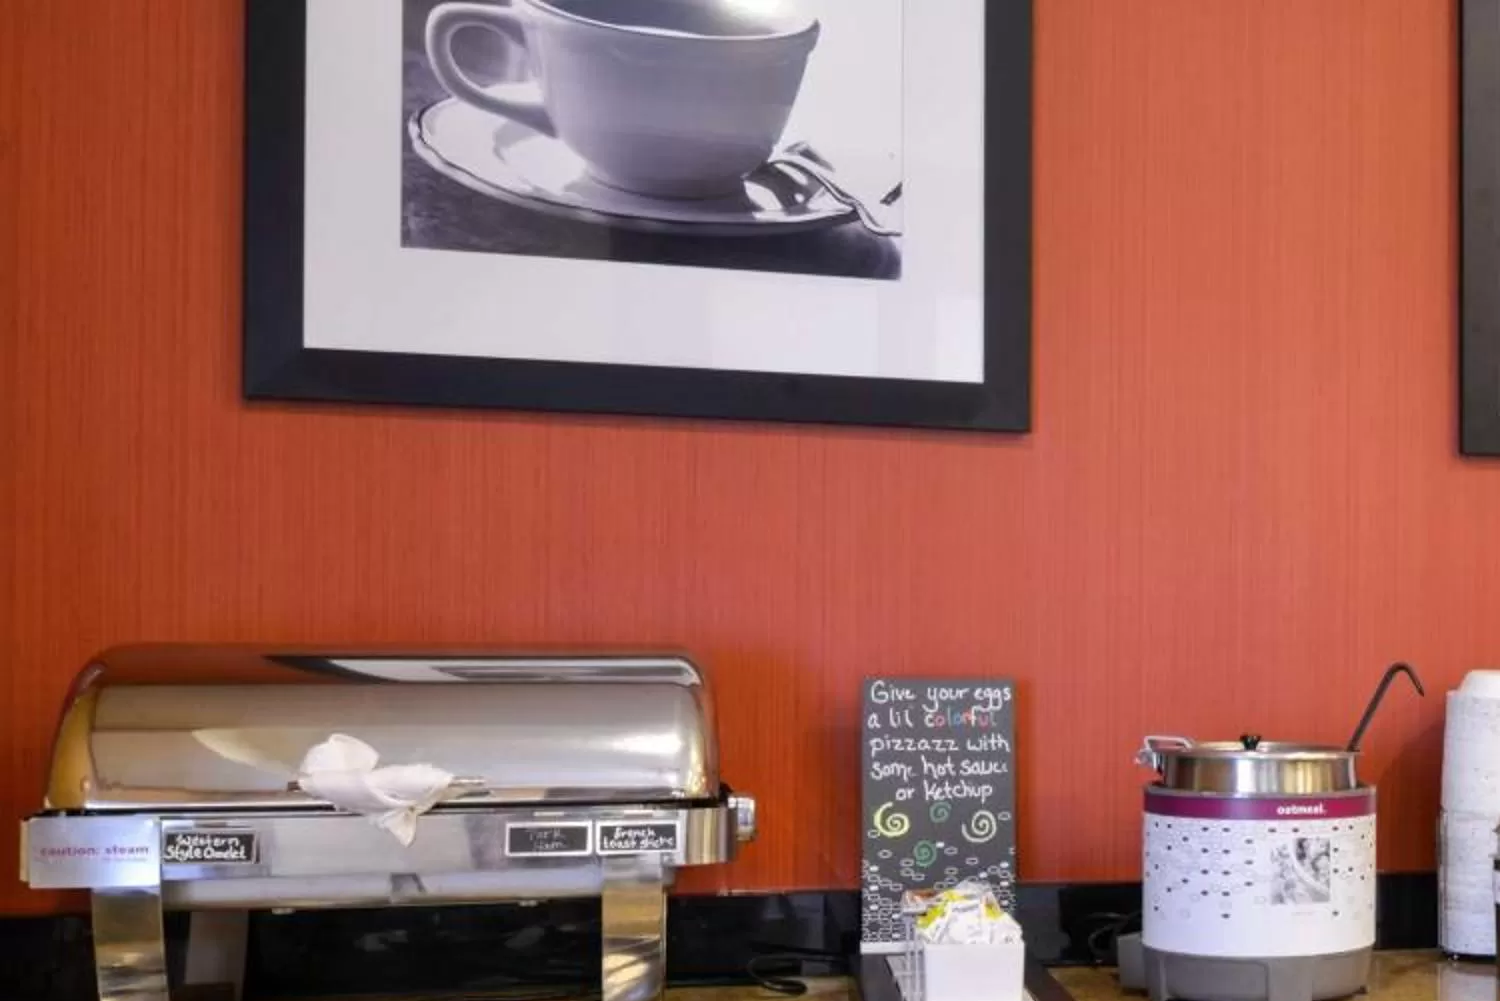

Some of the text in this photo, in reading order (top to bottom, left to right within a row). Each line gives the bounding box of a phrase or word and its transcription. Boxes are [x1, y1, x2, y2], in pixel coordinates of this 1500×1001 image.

[871, 680, 1011, 713] Give your eggs
[867, 712, 881, 729] a
[924, 704, 997, 728] colorful
[869, 732, 1010, 758] pizzazz with
[871, 755, 1008, 782] some hot sauce
[895, 787, 916, 801] or
